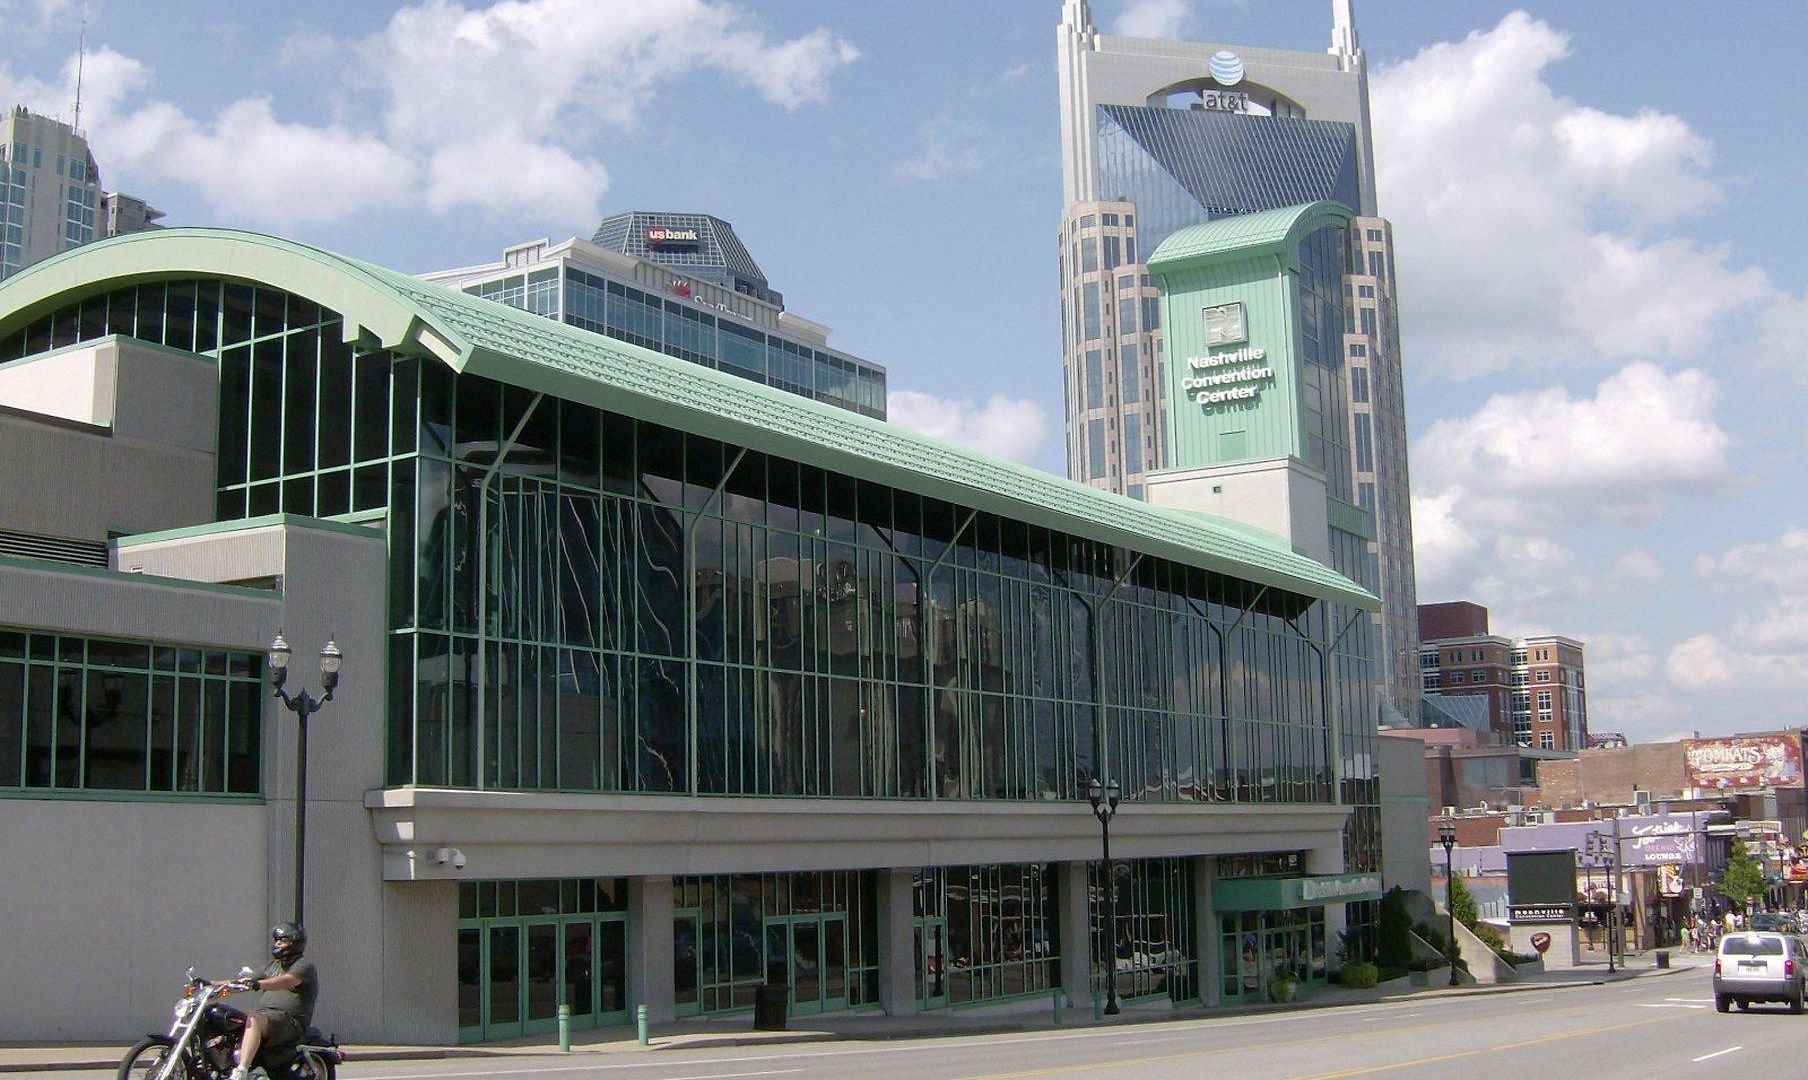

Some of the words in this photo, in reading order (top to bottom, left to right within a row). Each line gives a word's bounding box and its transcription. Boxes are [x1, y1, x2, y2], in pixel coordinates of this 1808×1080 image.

[1206, 91, 1247, 111] at&t
[1187, 347, 1264, 370] Nashville
[1181, 367, 1272, 390] Convention
[1196, 385, 1257, 404] Center
